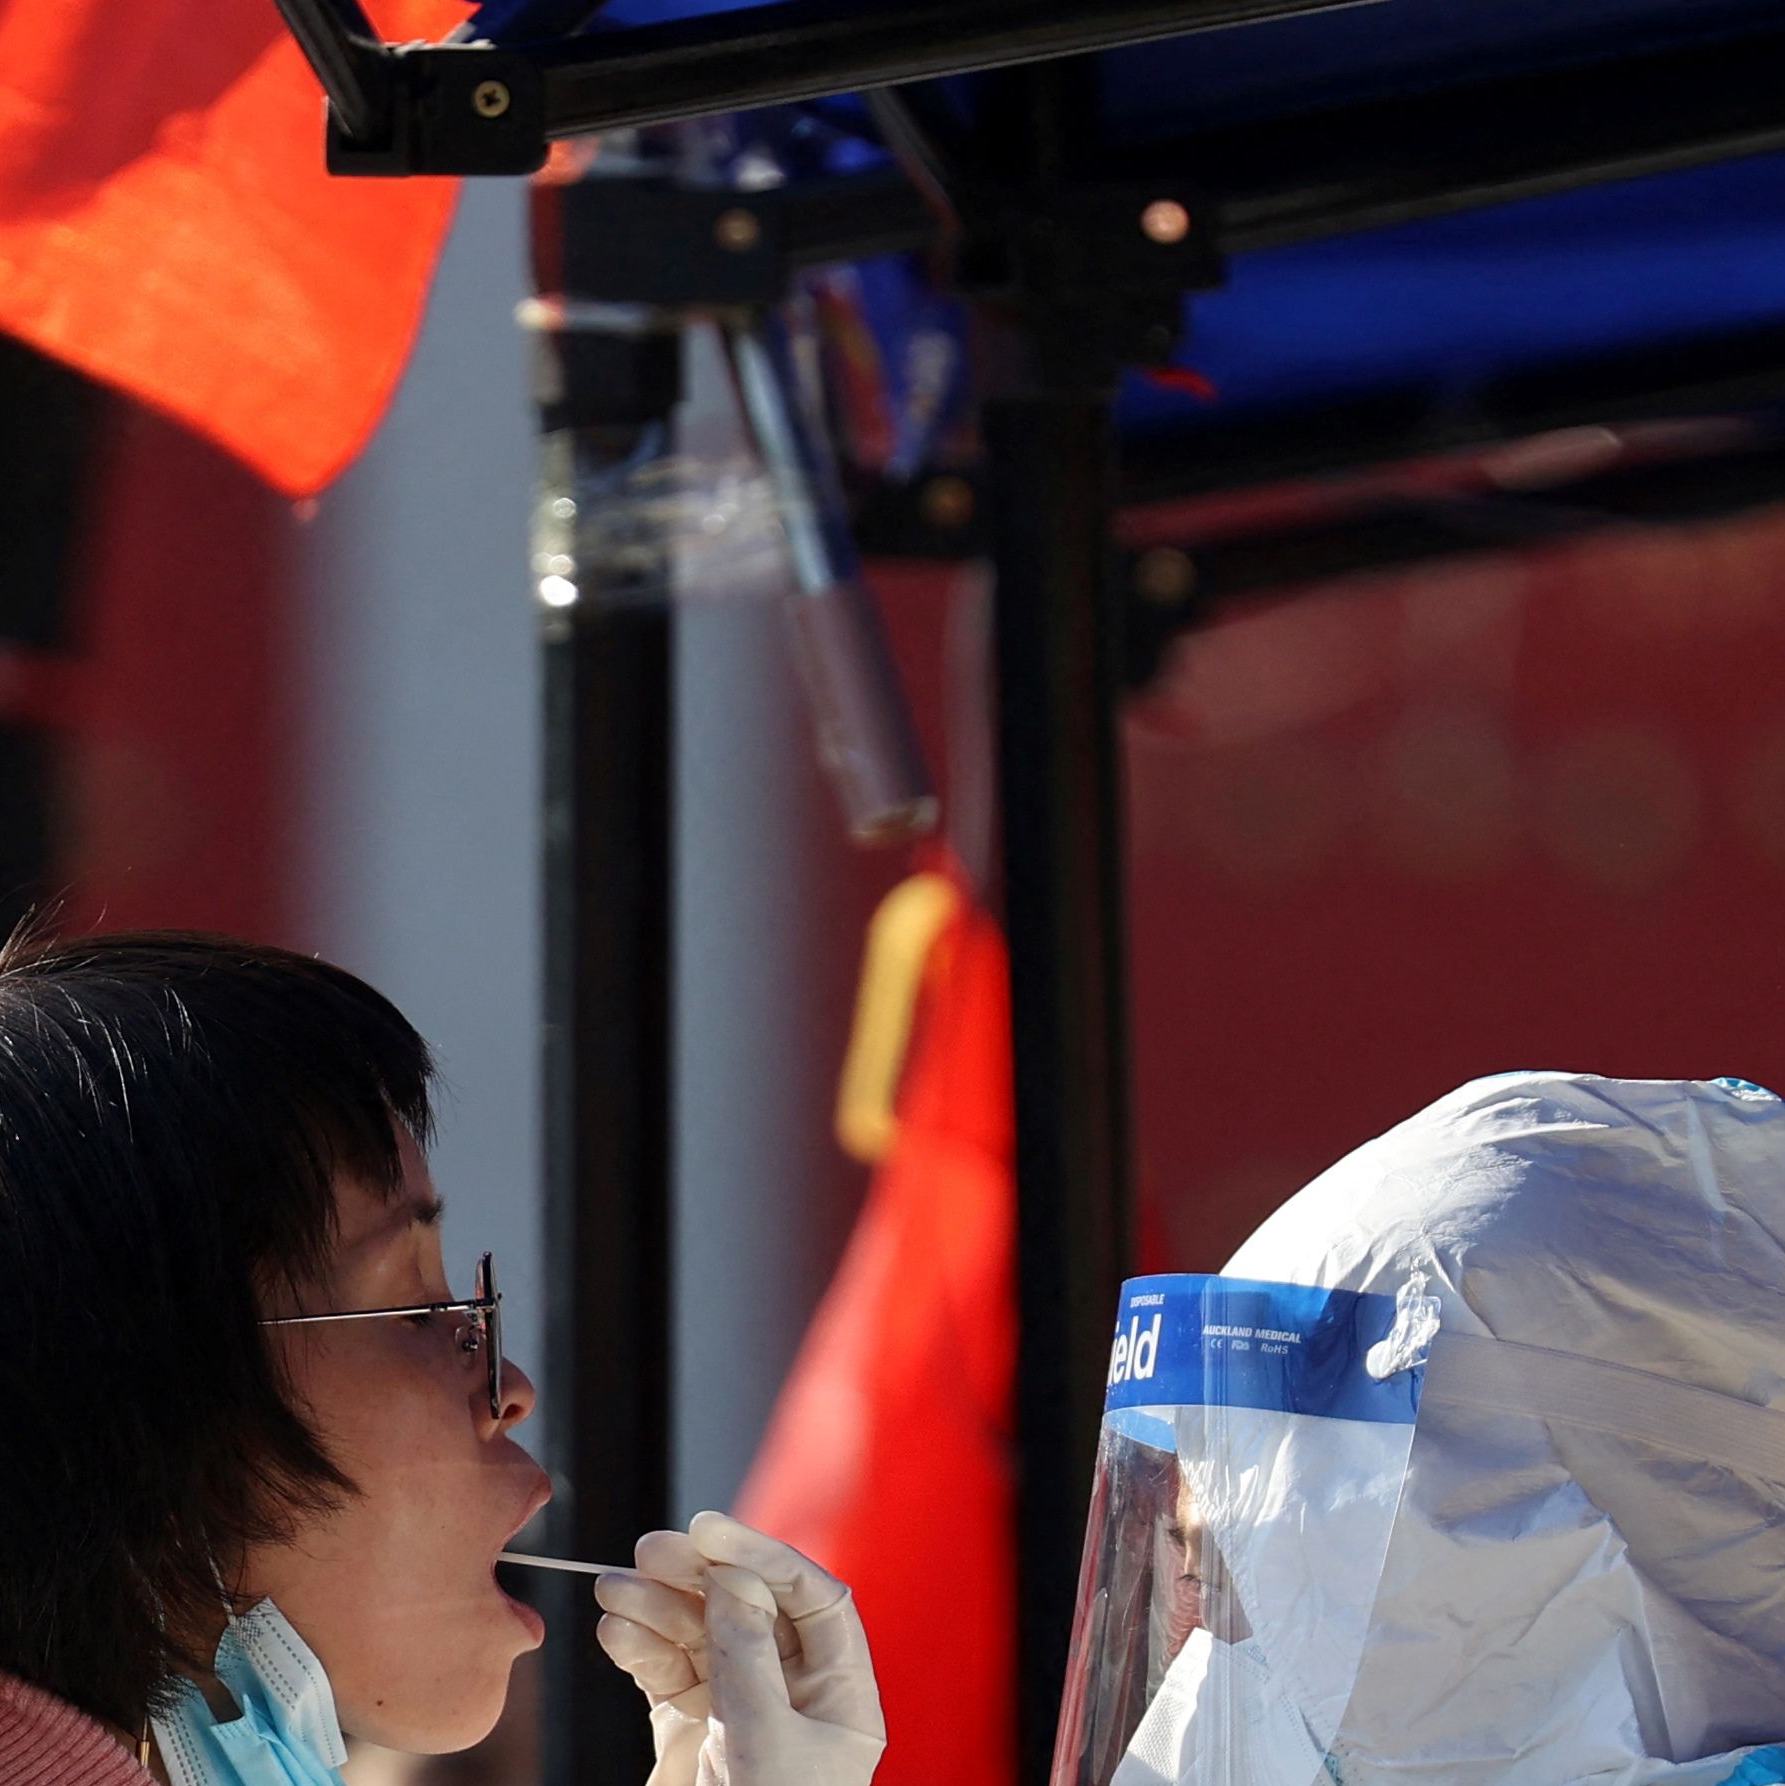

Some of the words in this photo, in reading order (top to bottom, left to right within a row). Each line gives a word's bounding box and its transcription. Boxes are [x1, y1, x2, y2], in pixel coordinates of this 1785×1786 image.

[1130, 1293, 1165, 1308] DISPOSABLE
[1202, 1324, 1252, 1338] AUCKLAND
[1254, 1328, 1301, 1344] MEDICAL
[1260, 1342, 1289, 1355] RoHS
